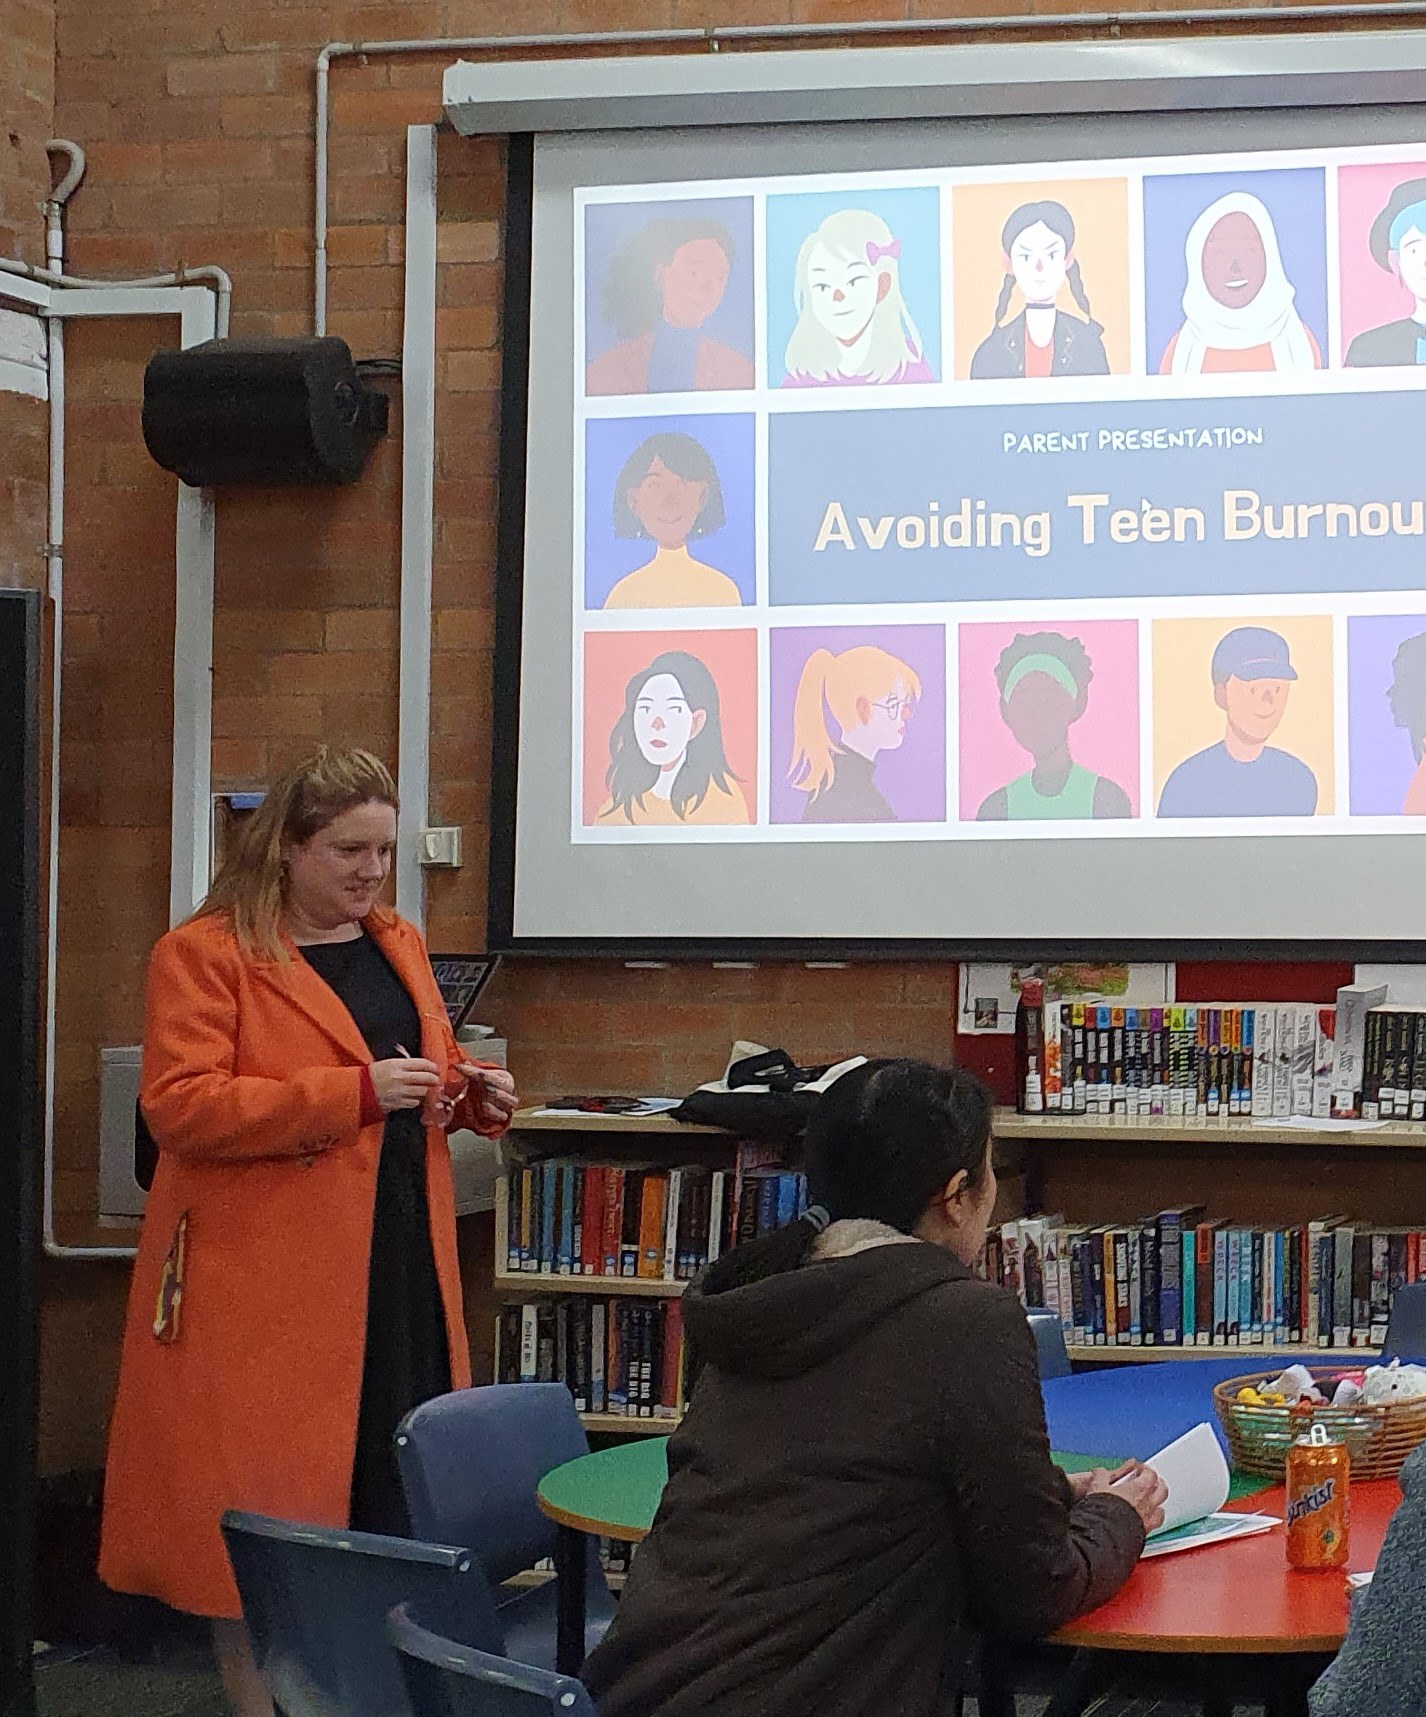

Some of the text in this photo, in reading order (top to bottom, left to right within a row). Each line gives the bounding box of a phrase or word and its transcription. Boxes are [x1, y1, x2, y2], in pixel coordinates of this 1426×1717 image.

[1003, 426, 1264, 454] PARENT PRESENTATION
[813, 498, 1052, 558] Avoiding
[1067, 492, 1206, 545] Teen
